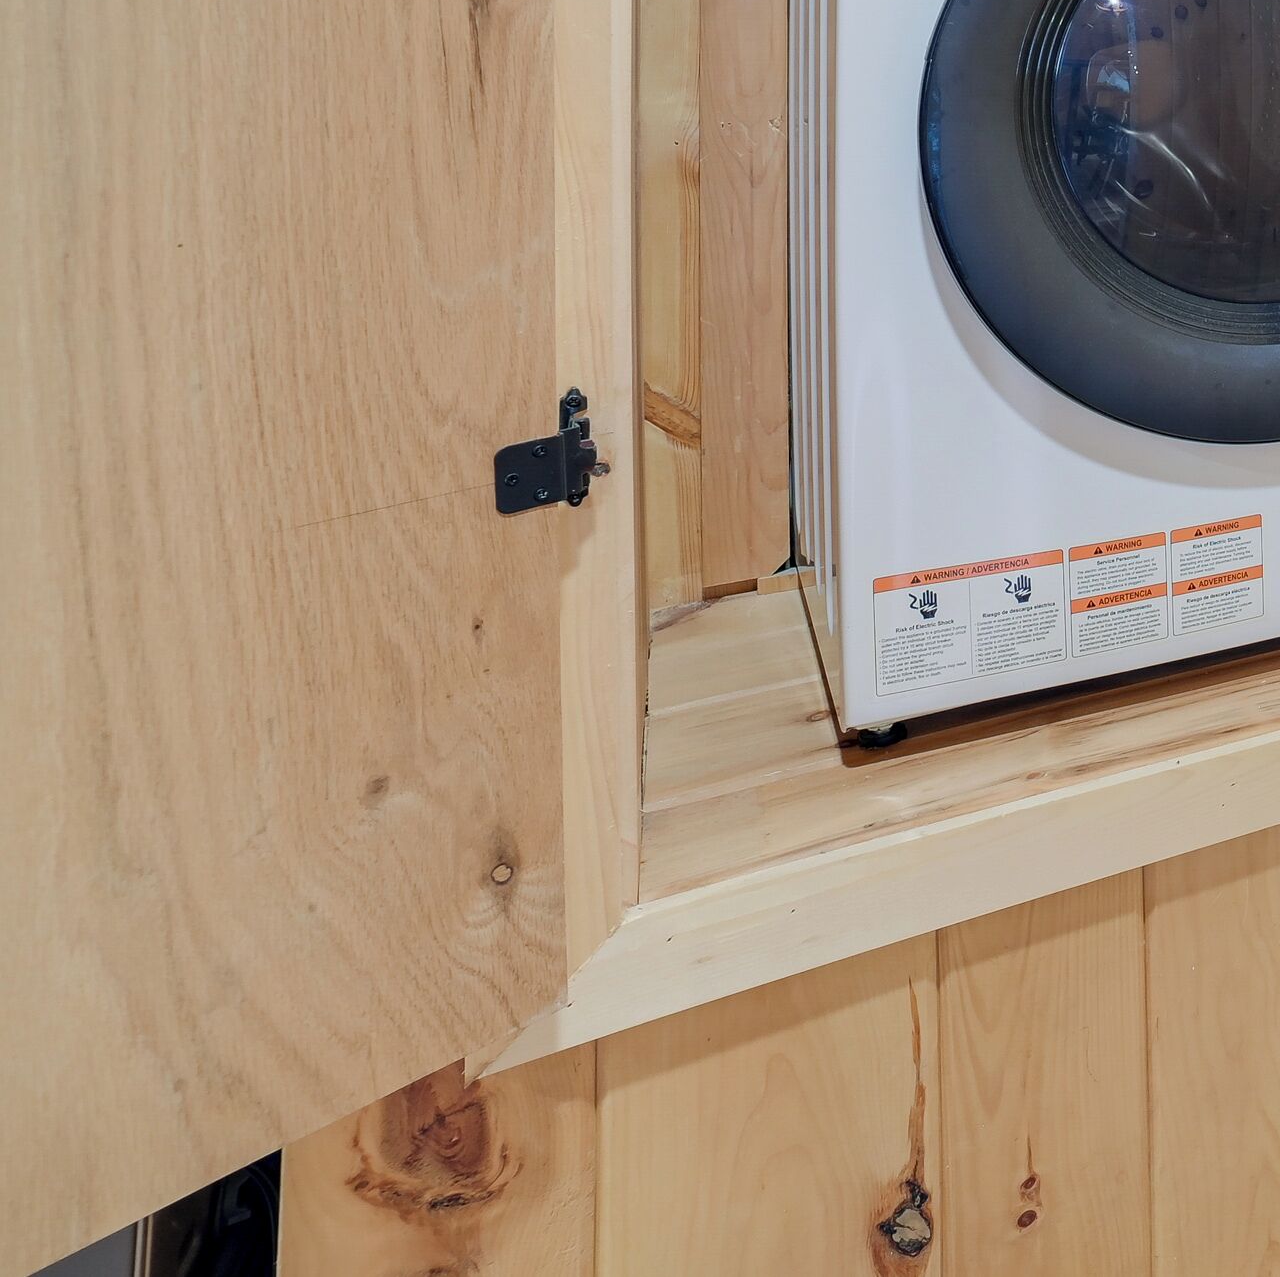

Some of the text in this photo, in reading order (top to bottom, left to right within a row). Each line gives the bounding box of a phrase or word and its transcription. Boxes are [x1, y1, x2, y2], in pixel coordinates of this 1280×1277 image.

[1205, 522, 1240, 534] WARNING
[1106, 539, 1142, 552] WARNING
[923, 568, 964, 581] WARNING
[971, 559, 1029, 574] ADVERTENCIA
[1198, 571, 1249, 588] ADVERTENCIA
[1098, 589, 1152, 605] ADVERTENCIA
